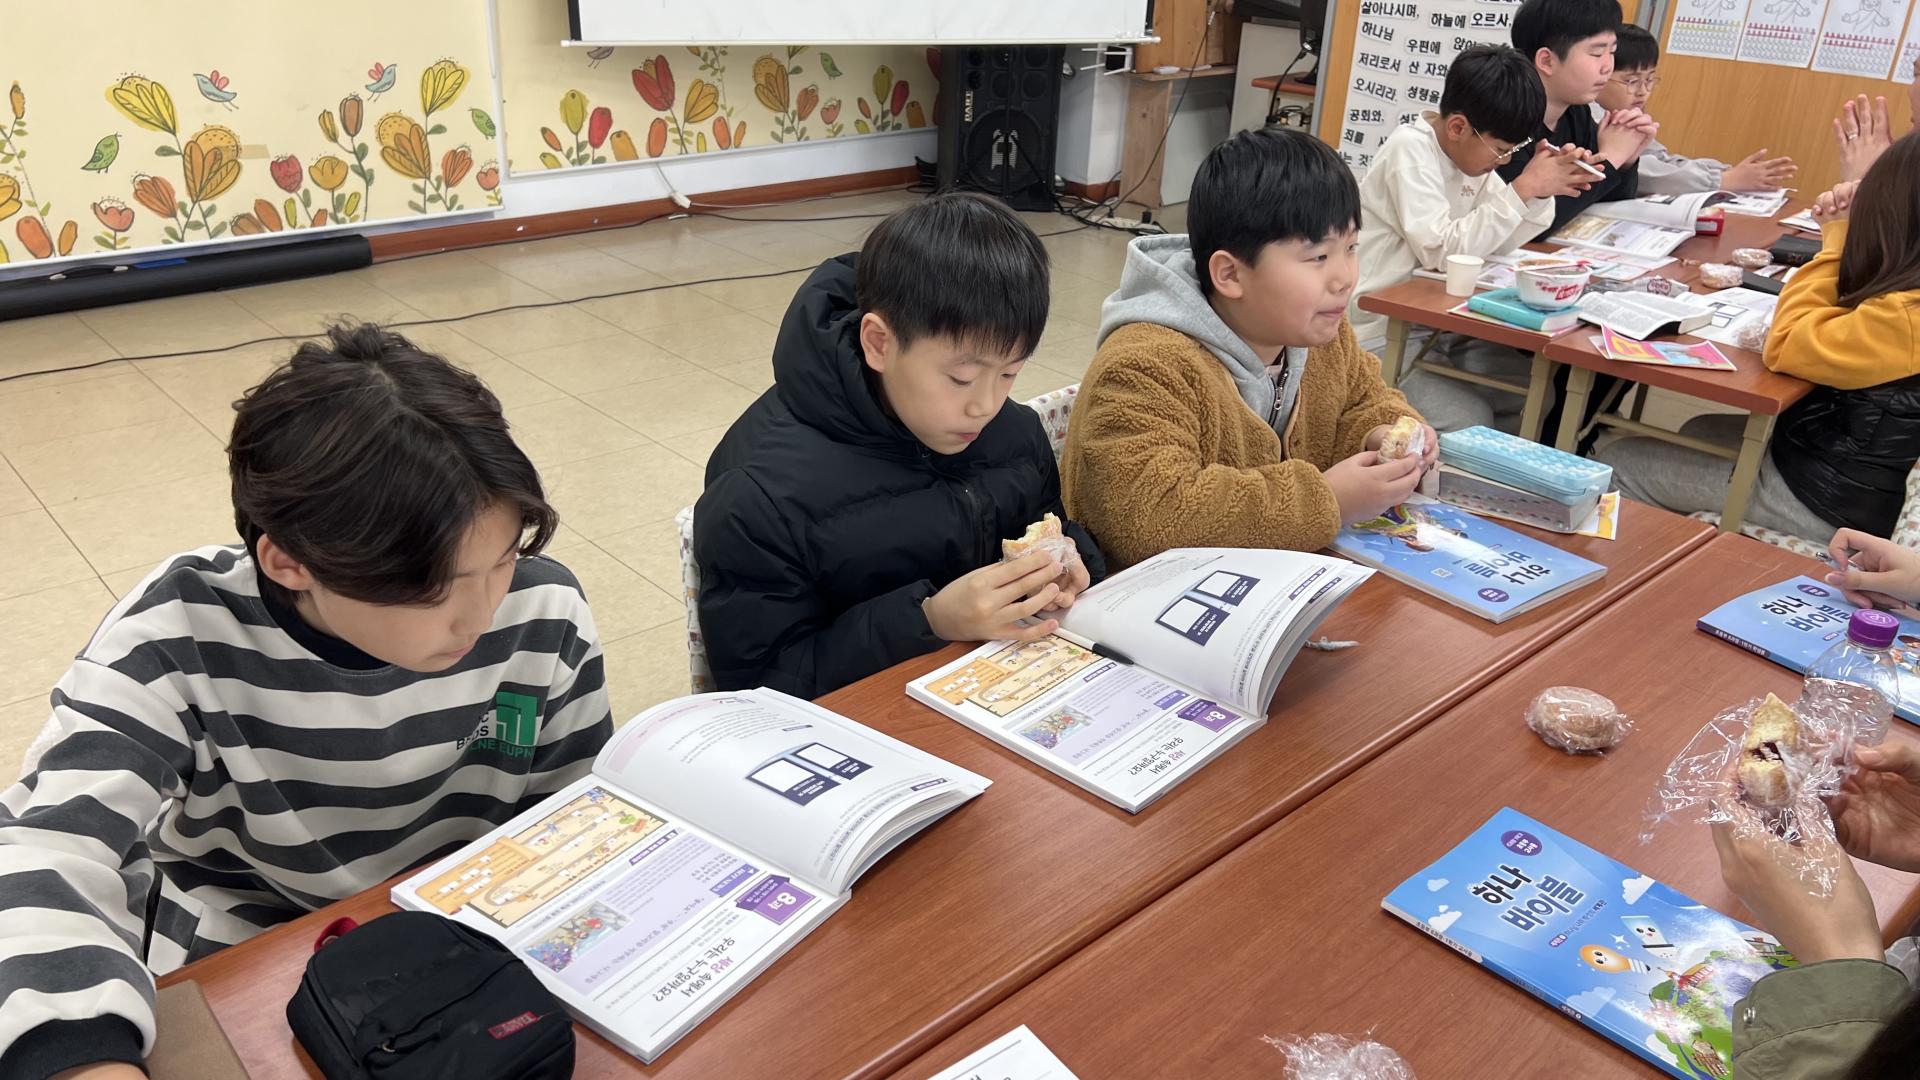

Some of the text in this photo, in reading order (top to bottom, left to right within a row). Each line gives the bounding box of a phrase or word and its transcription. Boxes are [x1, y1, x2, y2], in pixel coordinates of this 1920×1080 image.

[1431, 13, 1466, 28] 하늘에
[1471, 12, 1511, 27] 오르사,
[1362, 21, 1394, 41] 하나님
[1407, 39, 1441, 54] 우편에
[1359, 53, 1401, 72] 저리로서
[1408, 61, 1420, 74] 산
[1407, 86, 1440, 104] 성령을
[1464, 550, 1533, 578] 바이블
[1502, 564, 1552, 585] 하나
[1761, 595, 1812, 615] 하나
[1203, 711, 1226, 722] 8과
[1471, 864, 1532, 905] 하나
[767, 892, 797, 911] 8과
[1500, 875, 1584, 932] 바이블
[653, 937, 736, 1002] 우리는 누구일까요?
[680, 955, 734, 997] 세상 속에서
